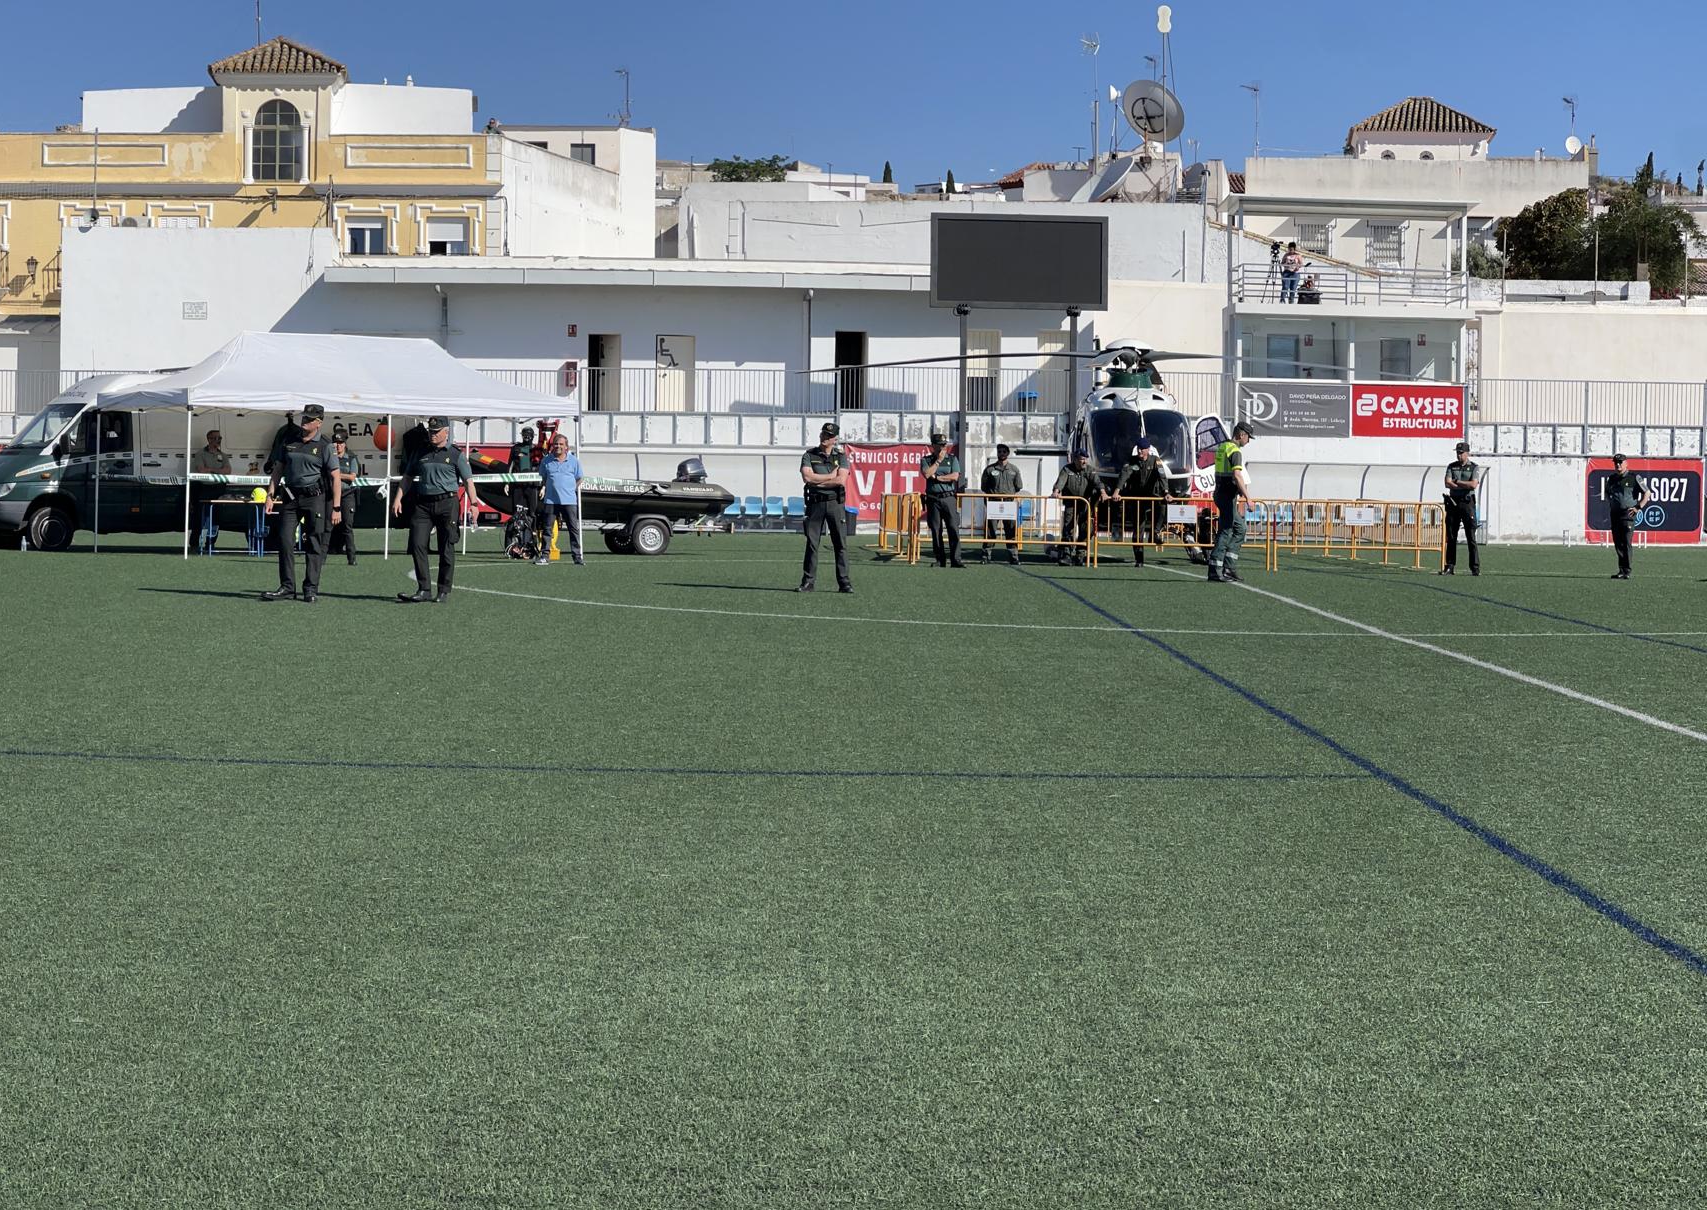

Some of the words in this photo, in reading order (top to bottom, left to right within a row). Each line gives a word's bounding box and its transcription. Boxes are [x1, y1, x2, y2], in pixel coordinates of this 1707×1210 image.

[1380, 396, 1459, 415] CAYSER
[1383, 417, 1457, 430] ESTRUCTURAS
[849, 452, 899, 463] SERVICIOS
